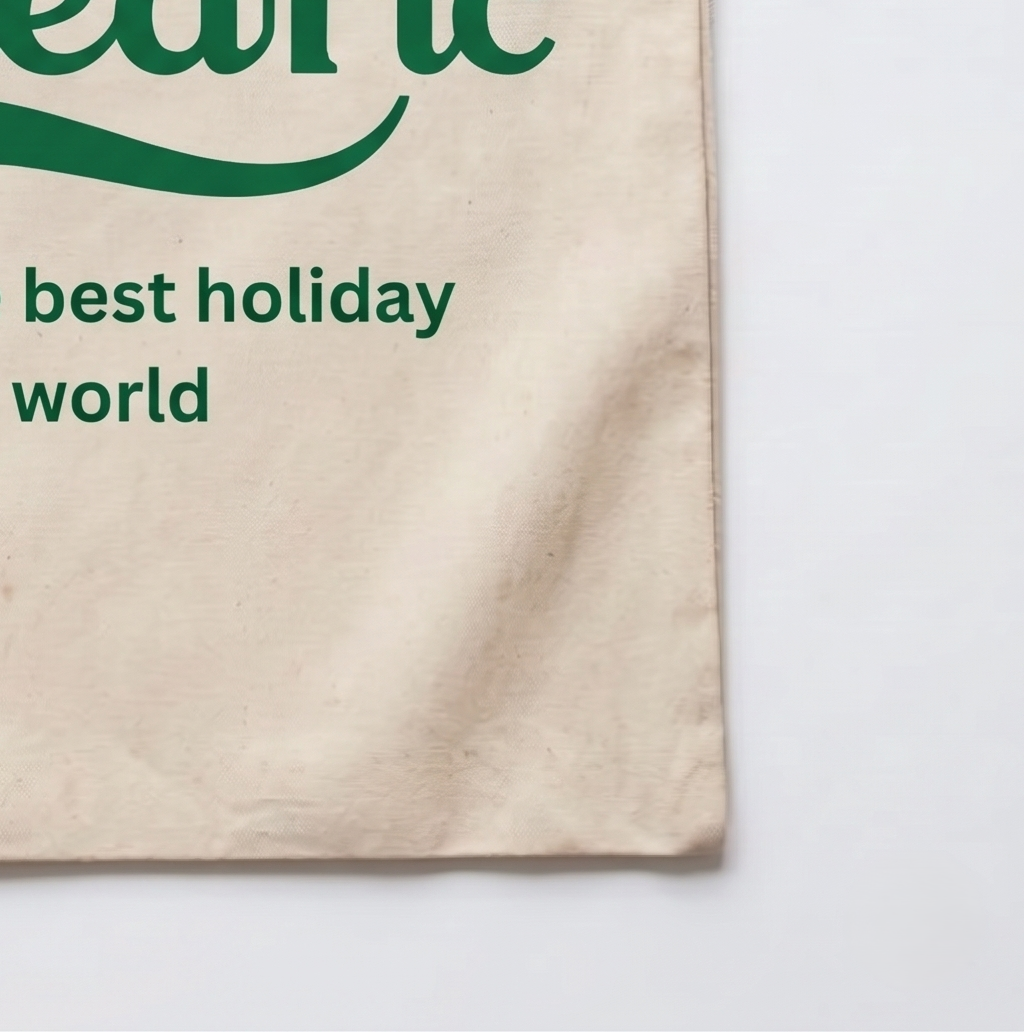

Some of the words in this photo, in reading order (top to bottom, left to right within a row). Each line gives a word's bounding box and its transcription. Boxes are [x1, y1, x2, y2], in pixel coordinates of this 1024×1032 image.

[24, 266, 177, 324] best
[197, 266, 456, 340] holiday
[12, 366, 209, 424] world
